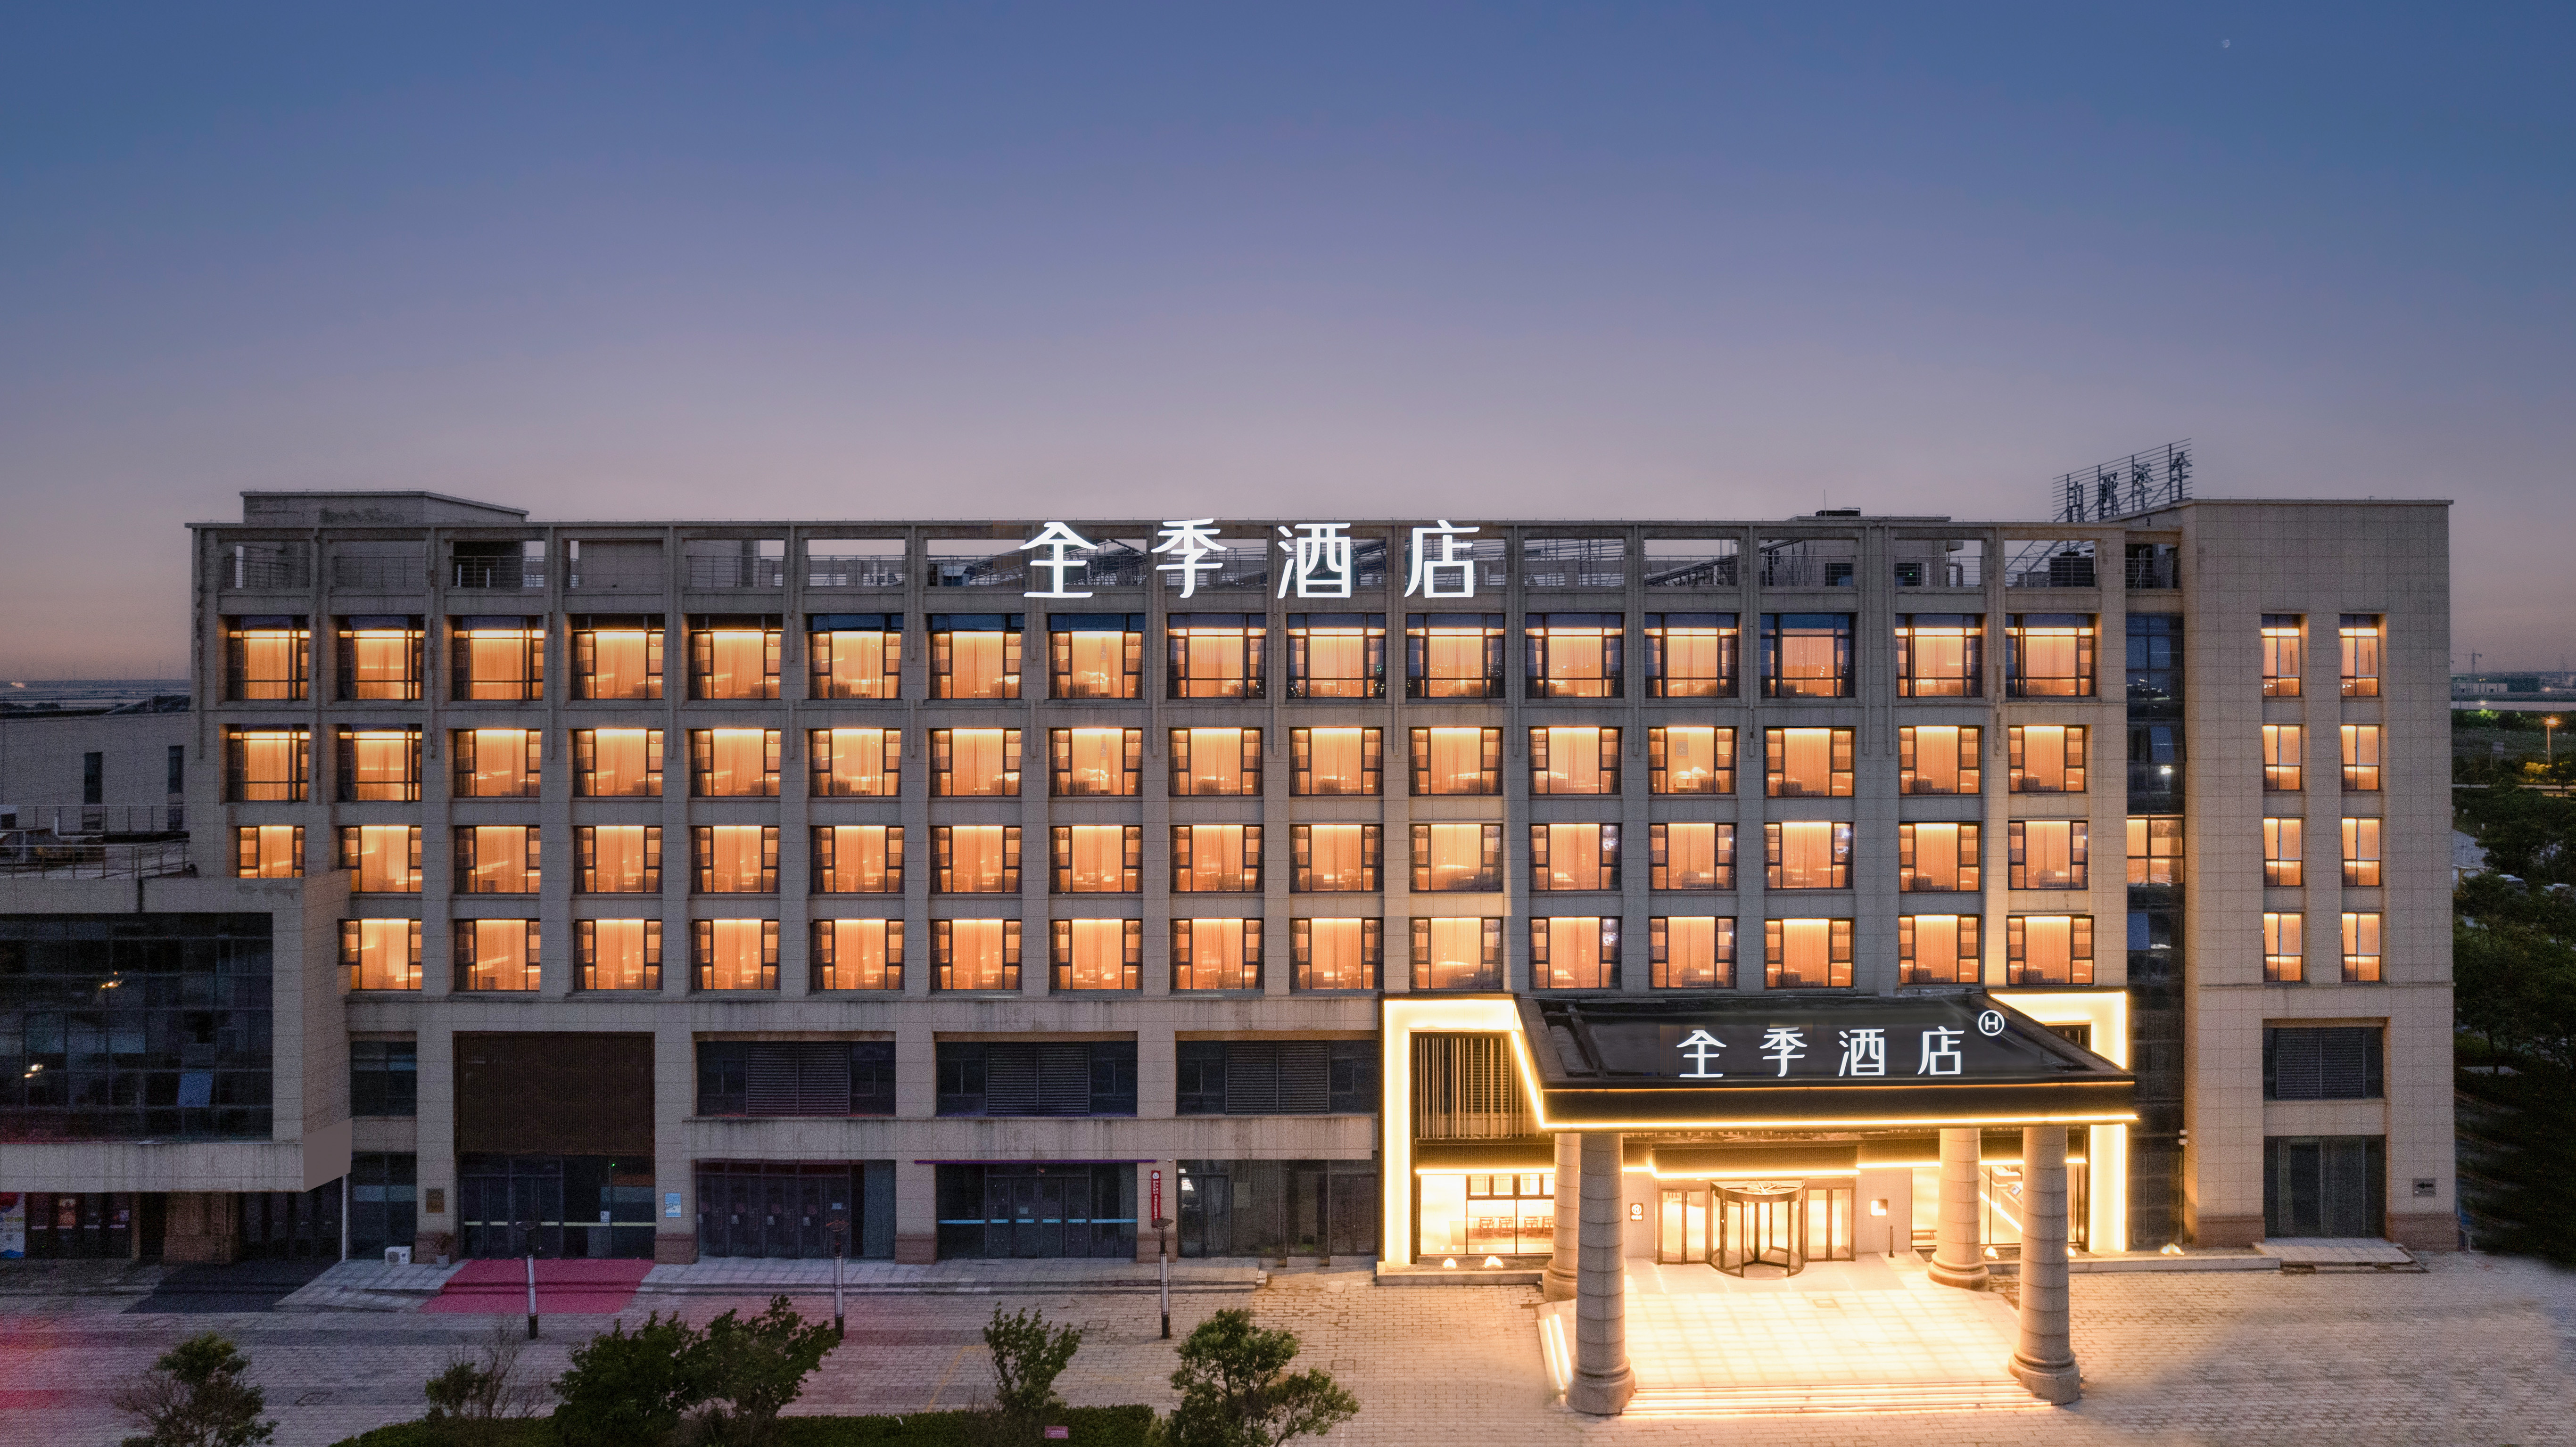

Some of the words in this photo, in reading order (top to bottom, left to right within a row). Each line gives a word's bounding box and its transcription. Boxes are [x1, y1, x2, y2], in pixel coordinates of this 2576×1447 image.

[1019, 518, 1480, 598] 全季酒店
[1676, 1026, 1965, 1078] 全季酒店
